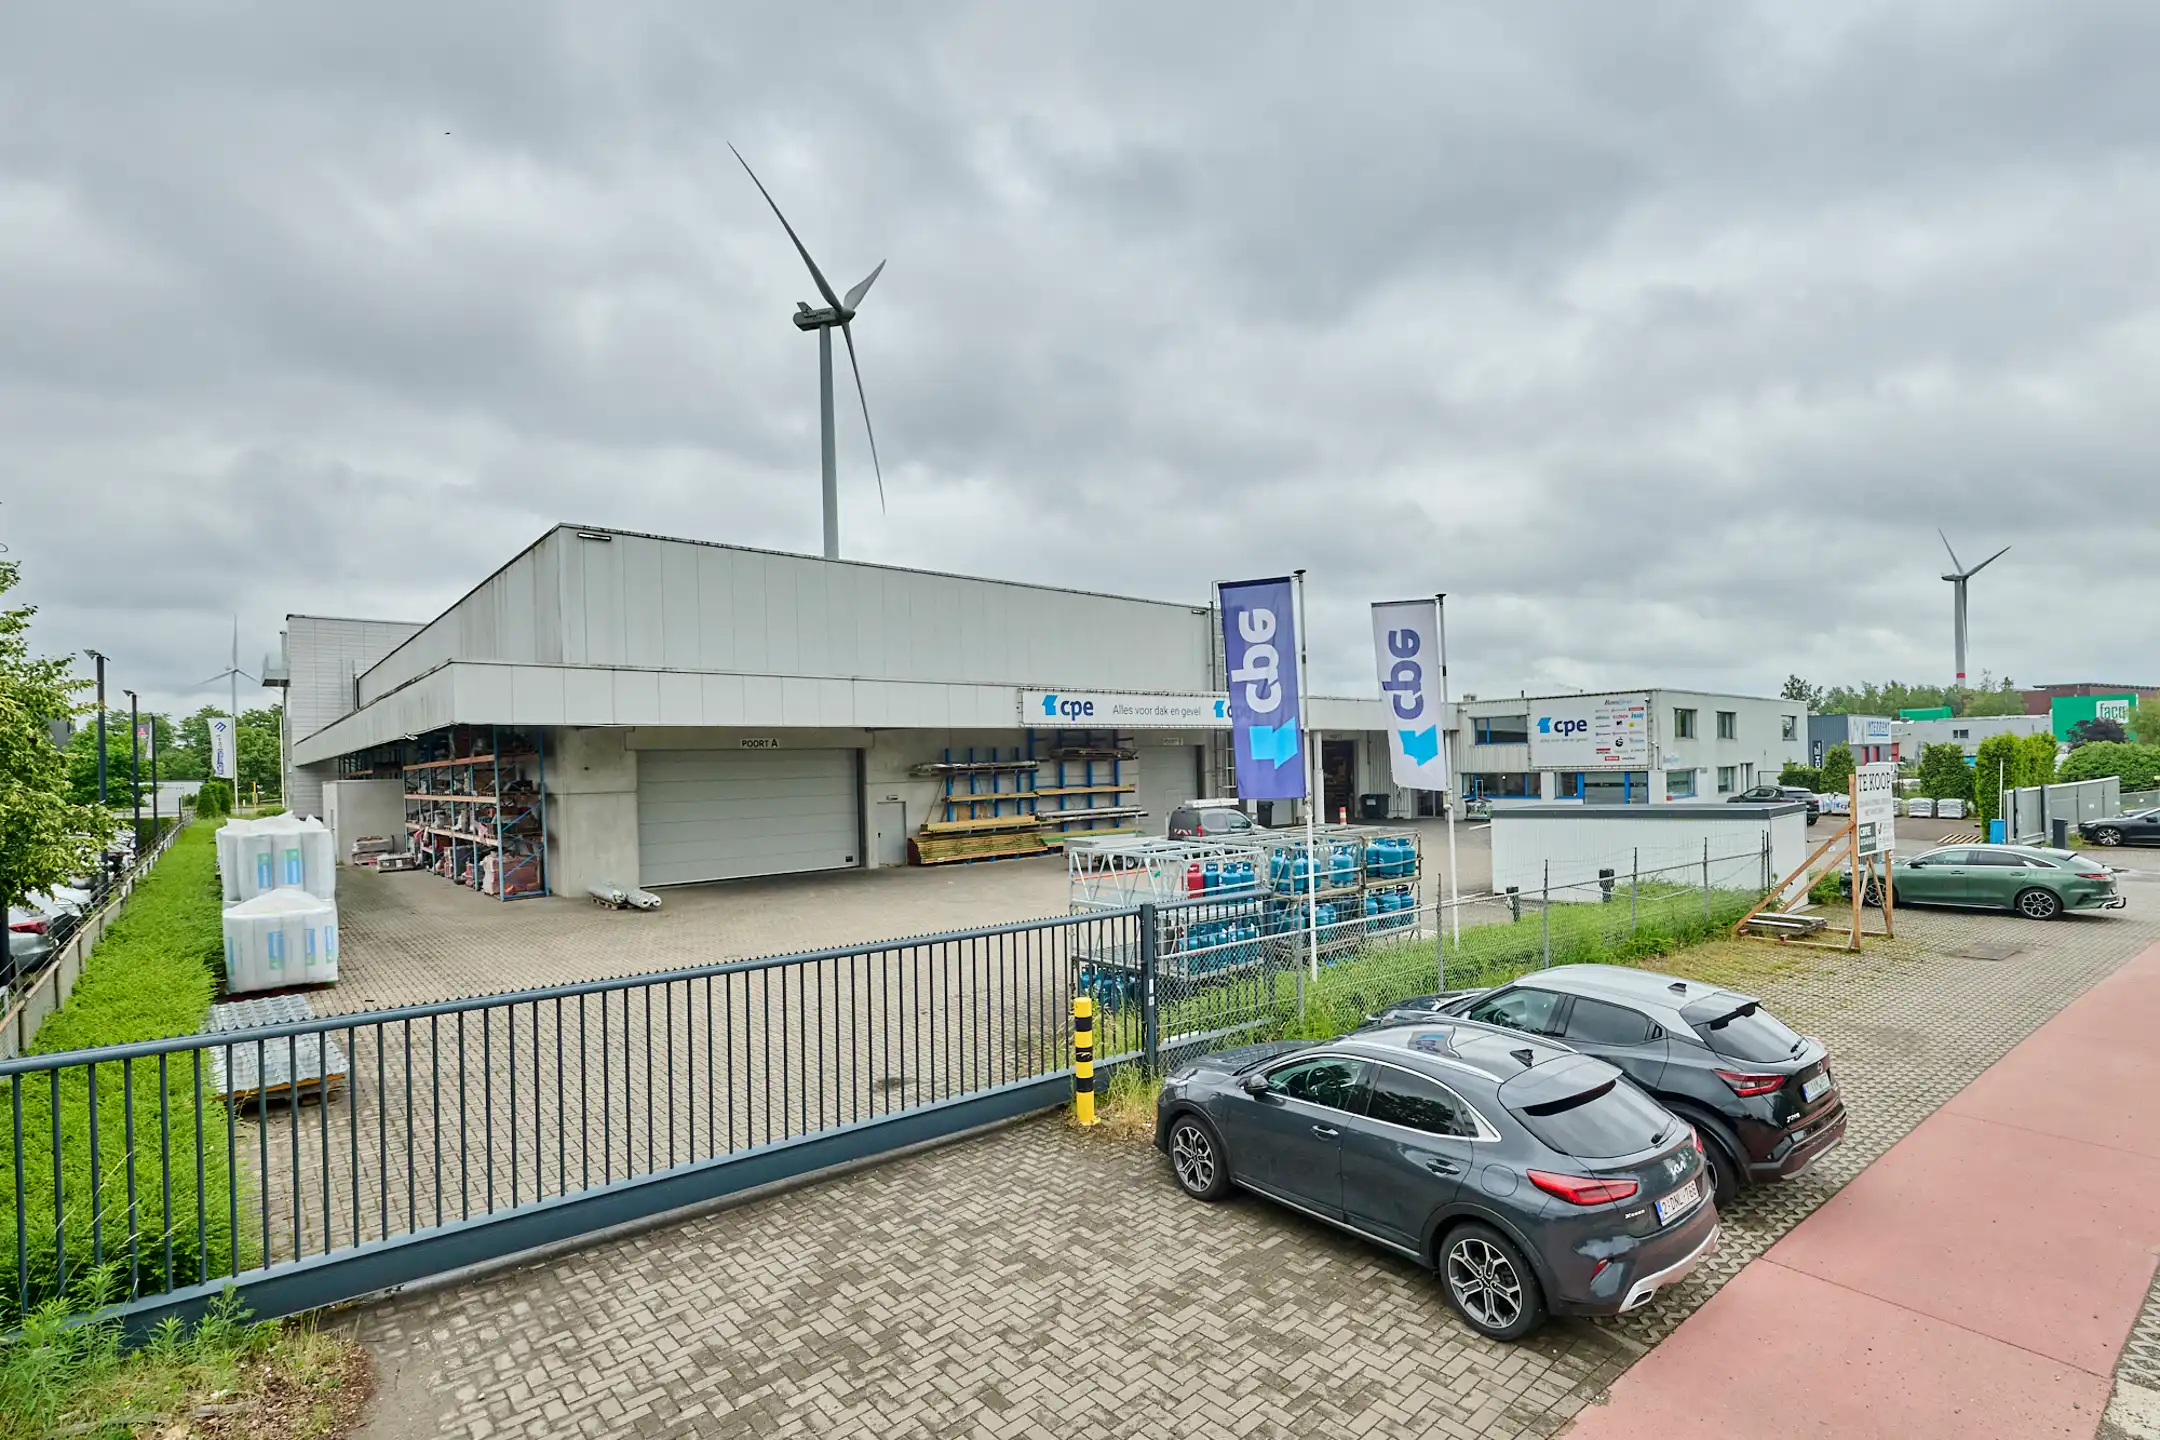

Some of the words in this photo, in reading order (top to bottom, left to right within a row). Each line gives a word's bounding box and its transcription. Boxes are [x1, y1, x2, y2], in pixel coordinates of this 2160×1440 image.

[1060, 700, 1094, 721] cpe
[1112, 704, 1134, 716] Alles
[1134, 706, 1153, 716] voor
[1154, 705, 1169, 716] dak
[1170, 708, 1180, 716] en
[1181, 706, 1201, 718] gevel
[1553, 719, 1588, 737] cpe
[741, 739, 769, 748] POORT
[771, 738, 778, 748] A
[1858, 773, 1868, 792] TE
[1869, 772, 1891, 791] KOOP
